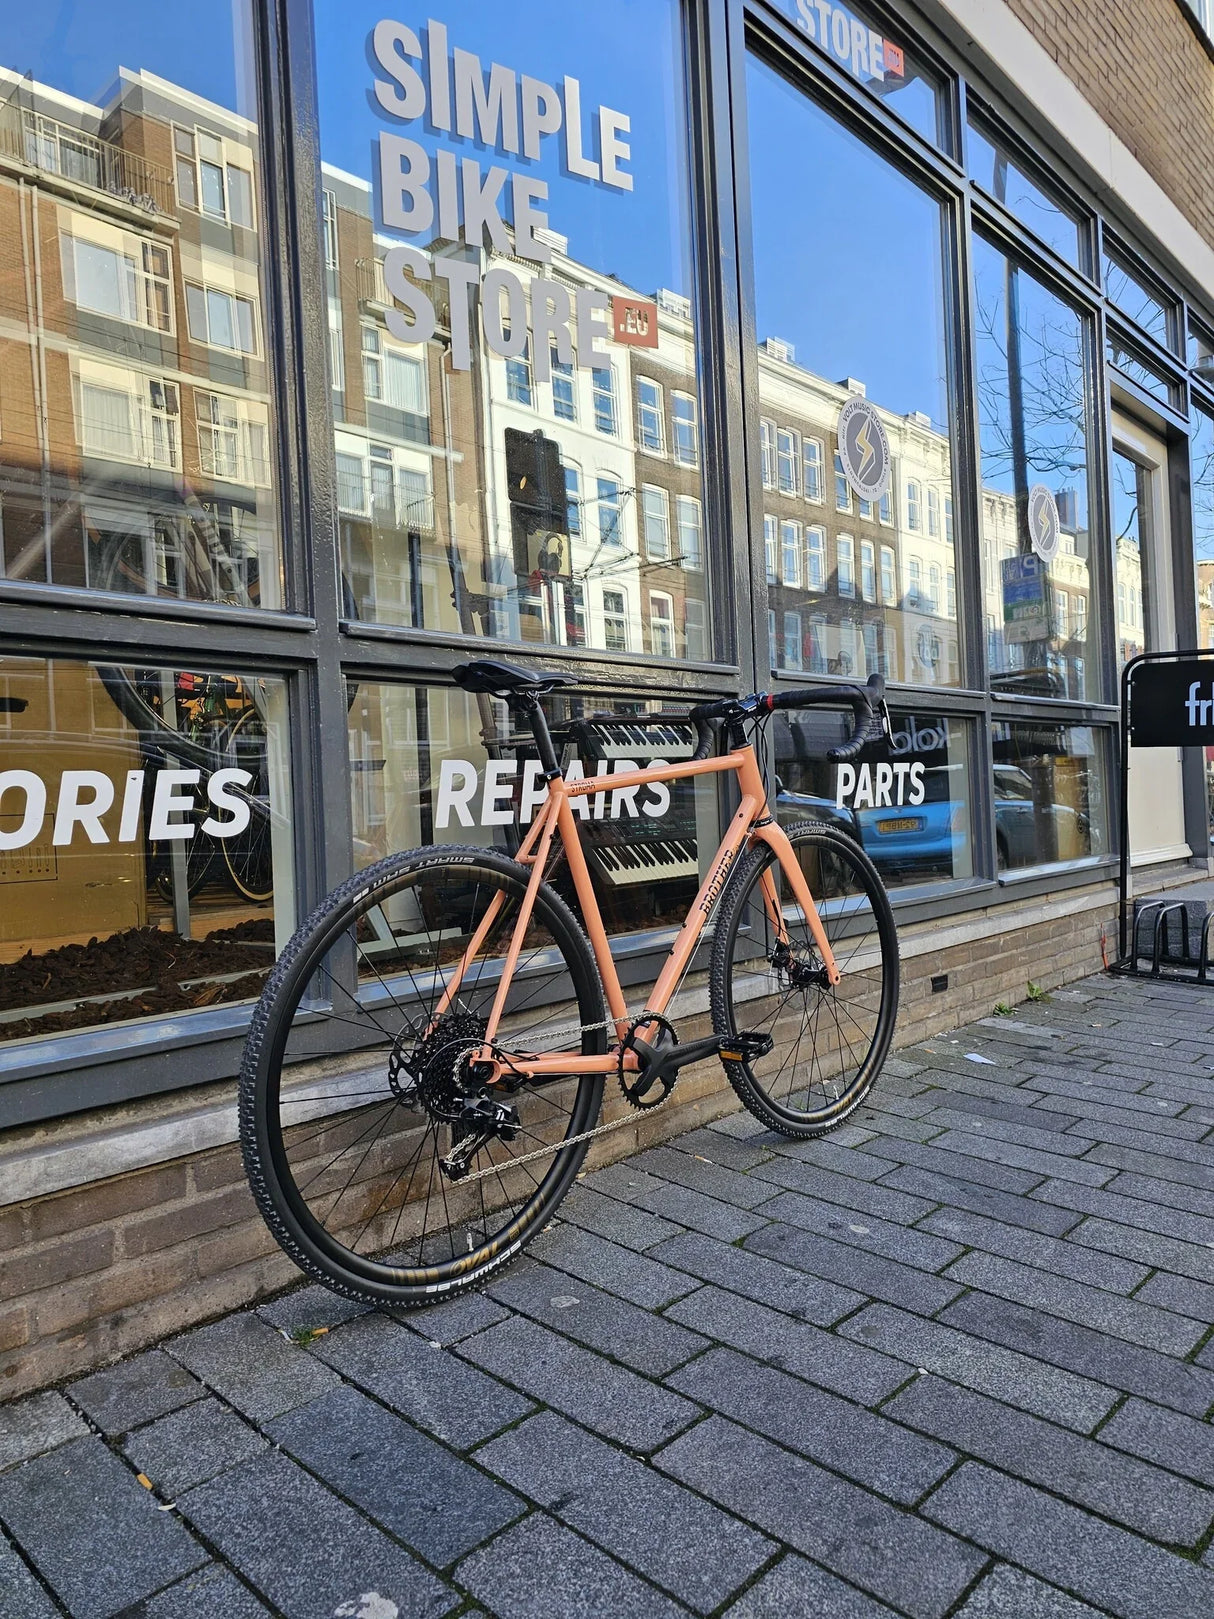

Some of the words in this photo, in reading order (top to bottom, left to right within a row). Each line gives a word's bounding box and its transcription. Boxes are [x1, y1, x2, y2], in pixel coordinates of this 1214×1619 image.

[797, 0, 884, 82] STORE
[373, 18, 634, 192] SIMPLE
[379, 130, 549, 263] BIKE
[384, 246, 611, 382] STORE
[619, 306, 649, 336] .EU
[1185, 681, 1214, 726] fr
[0, 768, 253, 851] ORIES
[435, 759, 671, 829] REPAIRS
[836, 761, 926, 810] PARTS
[373, 865, 411, 889] SAM
[415, 857, 475, 870] SMART
[699, 849, 733, 915] BROTHER
[425, 1240, 522, 1294] SCHWALBE
[450, 1241, 499, 1277] OVAL
